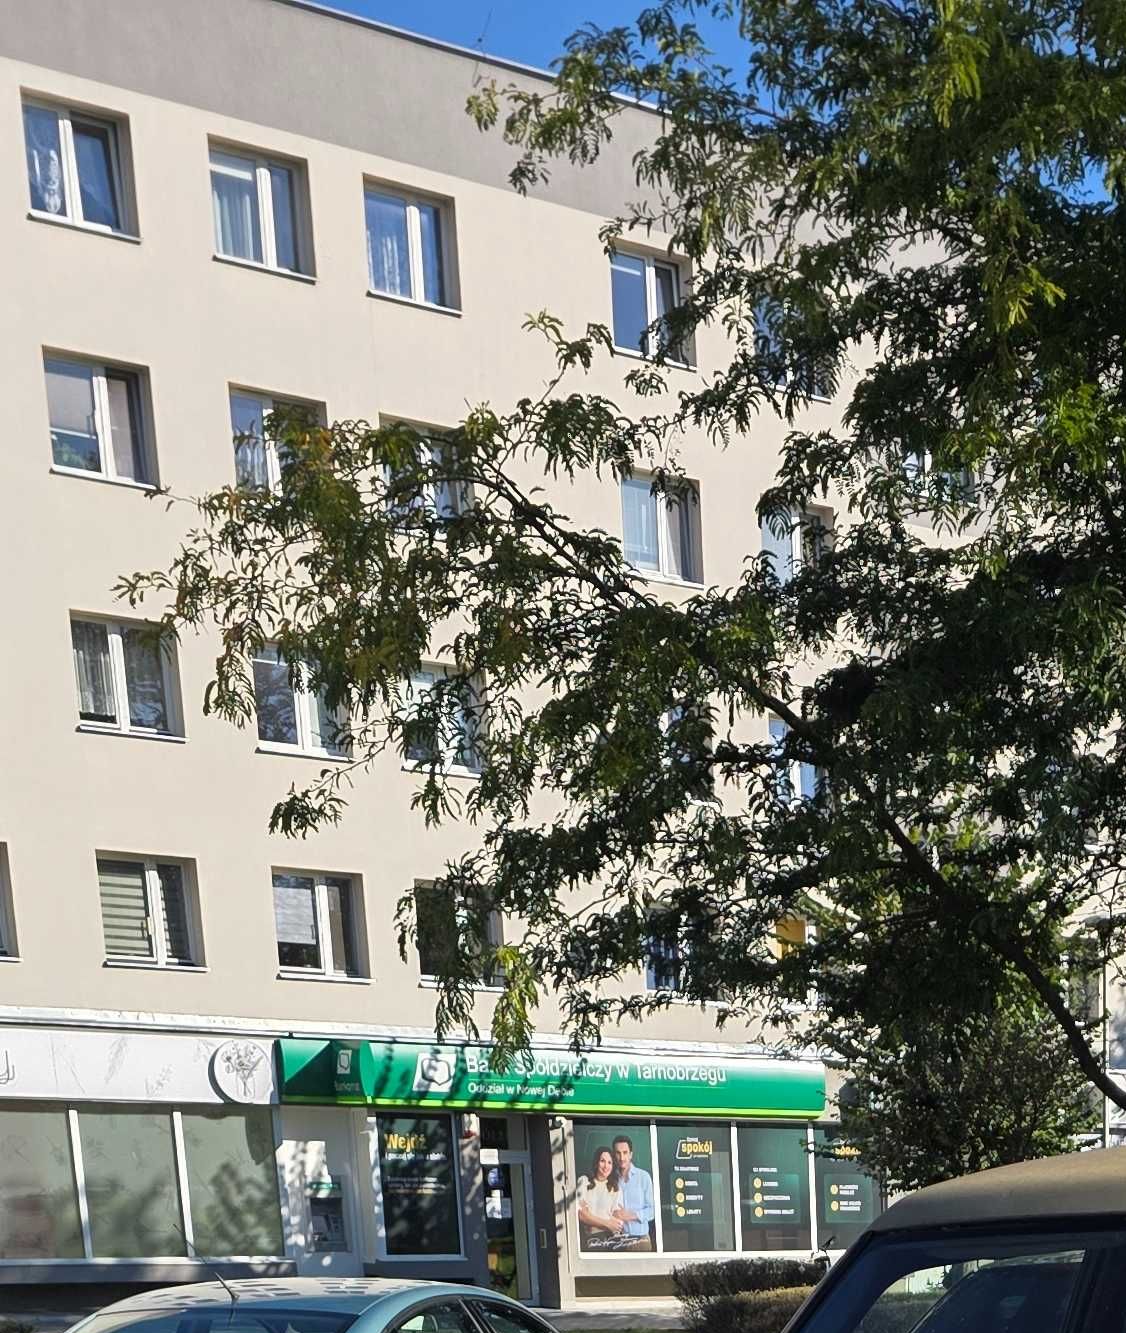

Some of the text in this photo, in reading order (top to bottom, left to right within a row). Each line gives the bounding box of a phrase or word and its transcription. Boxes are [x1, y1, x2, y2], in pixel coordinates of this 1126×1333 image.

[467, 1056, 509, 1073] Ba
[616, 1064, 630, 1078] w
[635, 1062, 727, 1086] Tarnobrzegu
[681, 1141, 713, 1155] spokój
